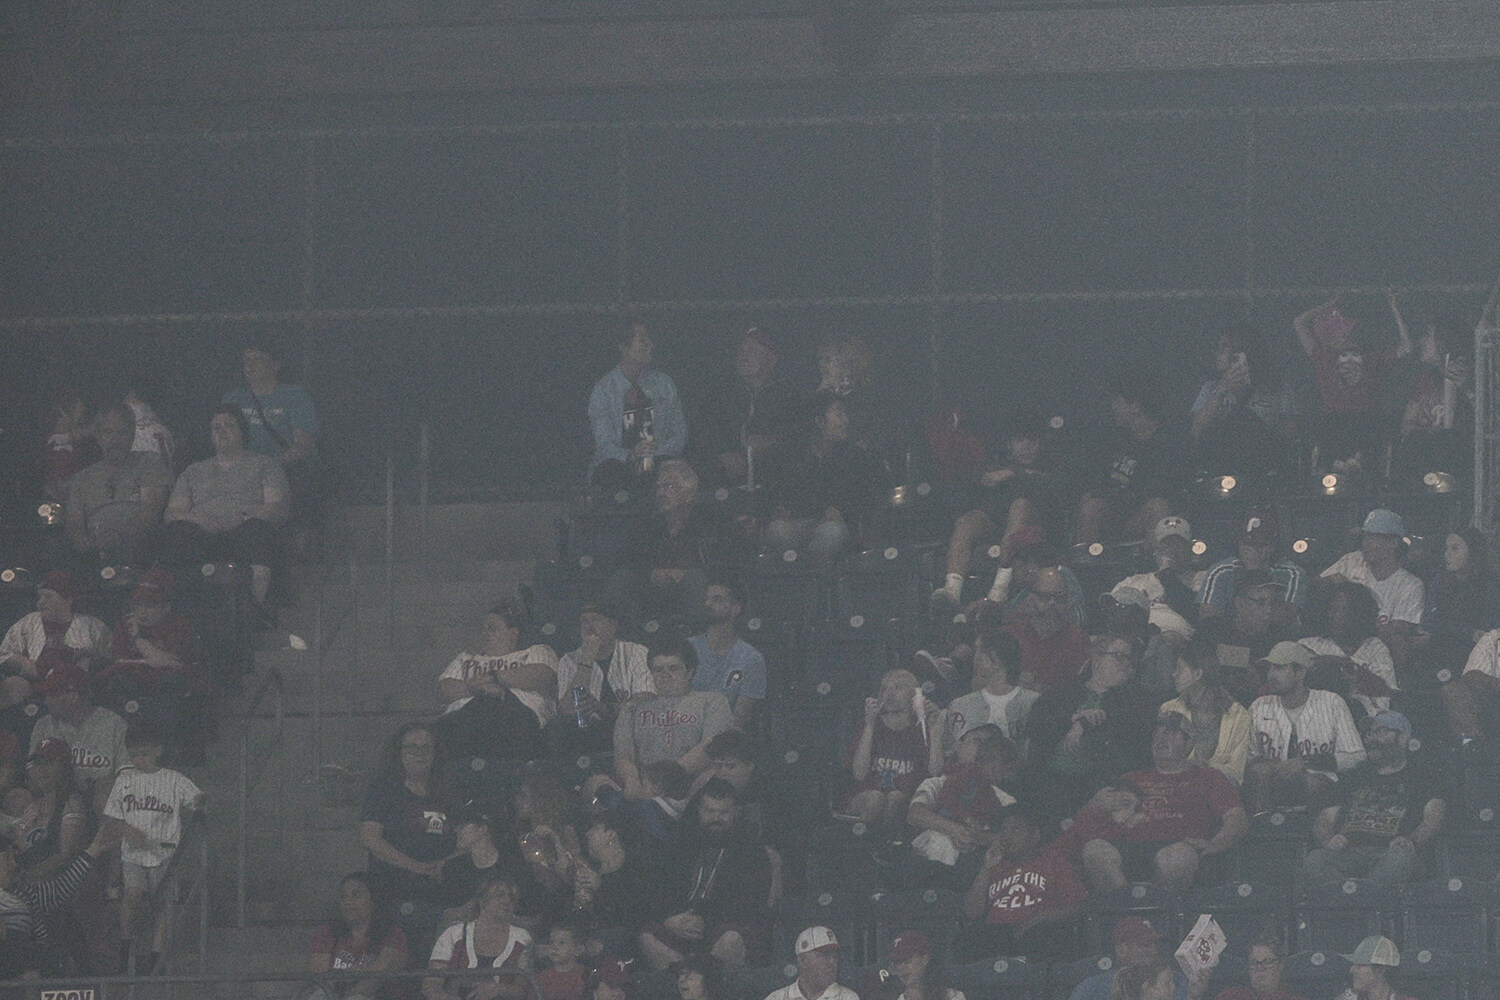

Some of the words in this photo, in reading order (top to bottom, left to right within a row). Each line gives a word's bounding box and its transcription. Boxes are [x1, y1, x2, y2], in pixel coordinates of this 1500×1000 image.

[463, 657, 523, 677] Phillie
[640, 710, 698, 728] Phillies
[72, 748, 112, 768] llies
[123, 794, 175, 816] Phillies
[1023, 872, 1046, 892] THE
